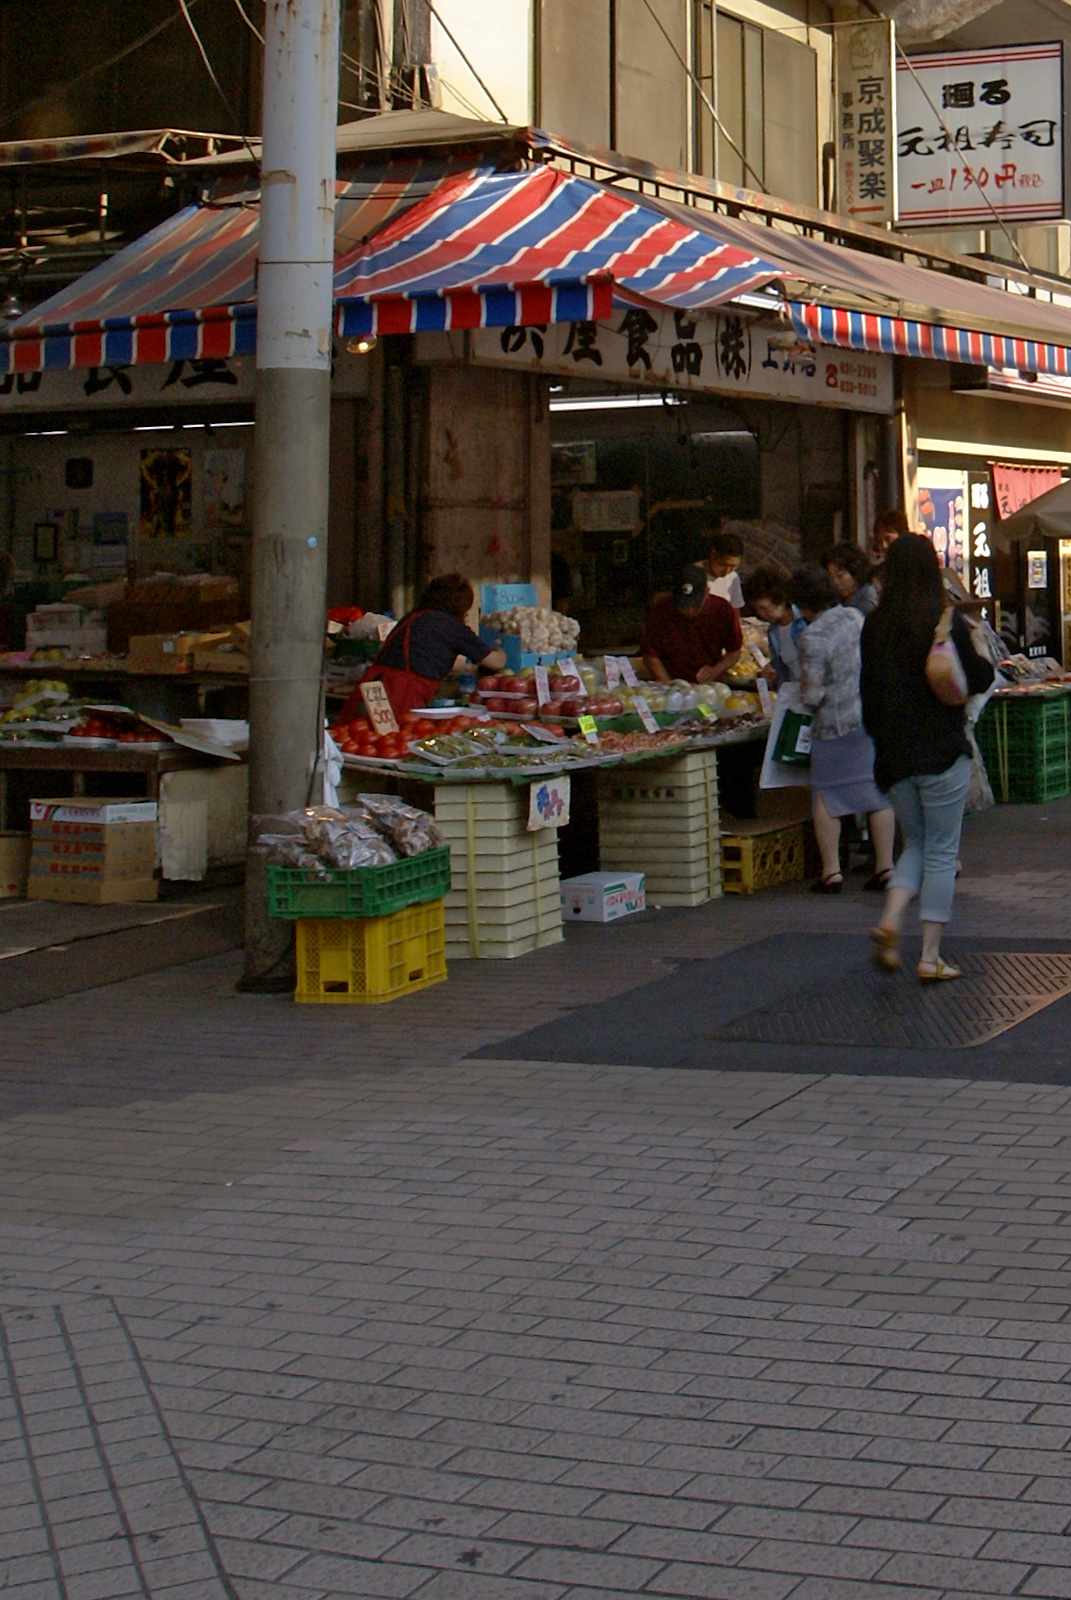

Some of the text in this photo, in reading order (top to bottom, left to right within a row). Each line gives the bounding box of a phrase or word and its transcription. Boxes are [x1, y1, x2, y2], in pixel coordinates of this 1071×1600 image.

[942, 78, 1011, 109] 廻る
[841, 92, 854, 149] 事務所
[857, 75, 886, 200] 京成聚楽
[898, 119, 1057, 157] 元祖寿司
